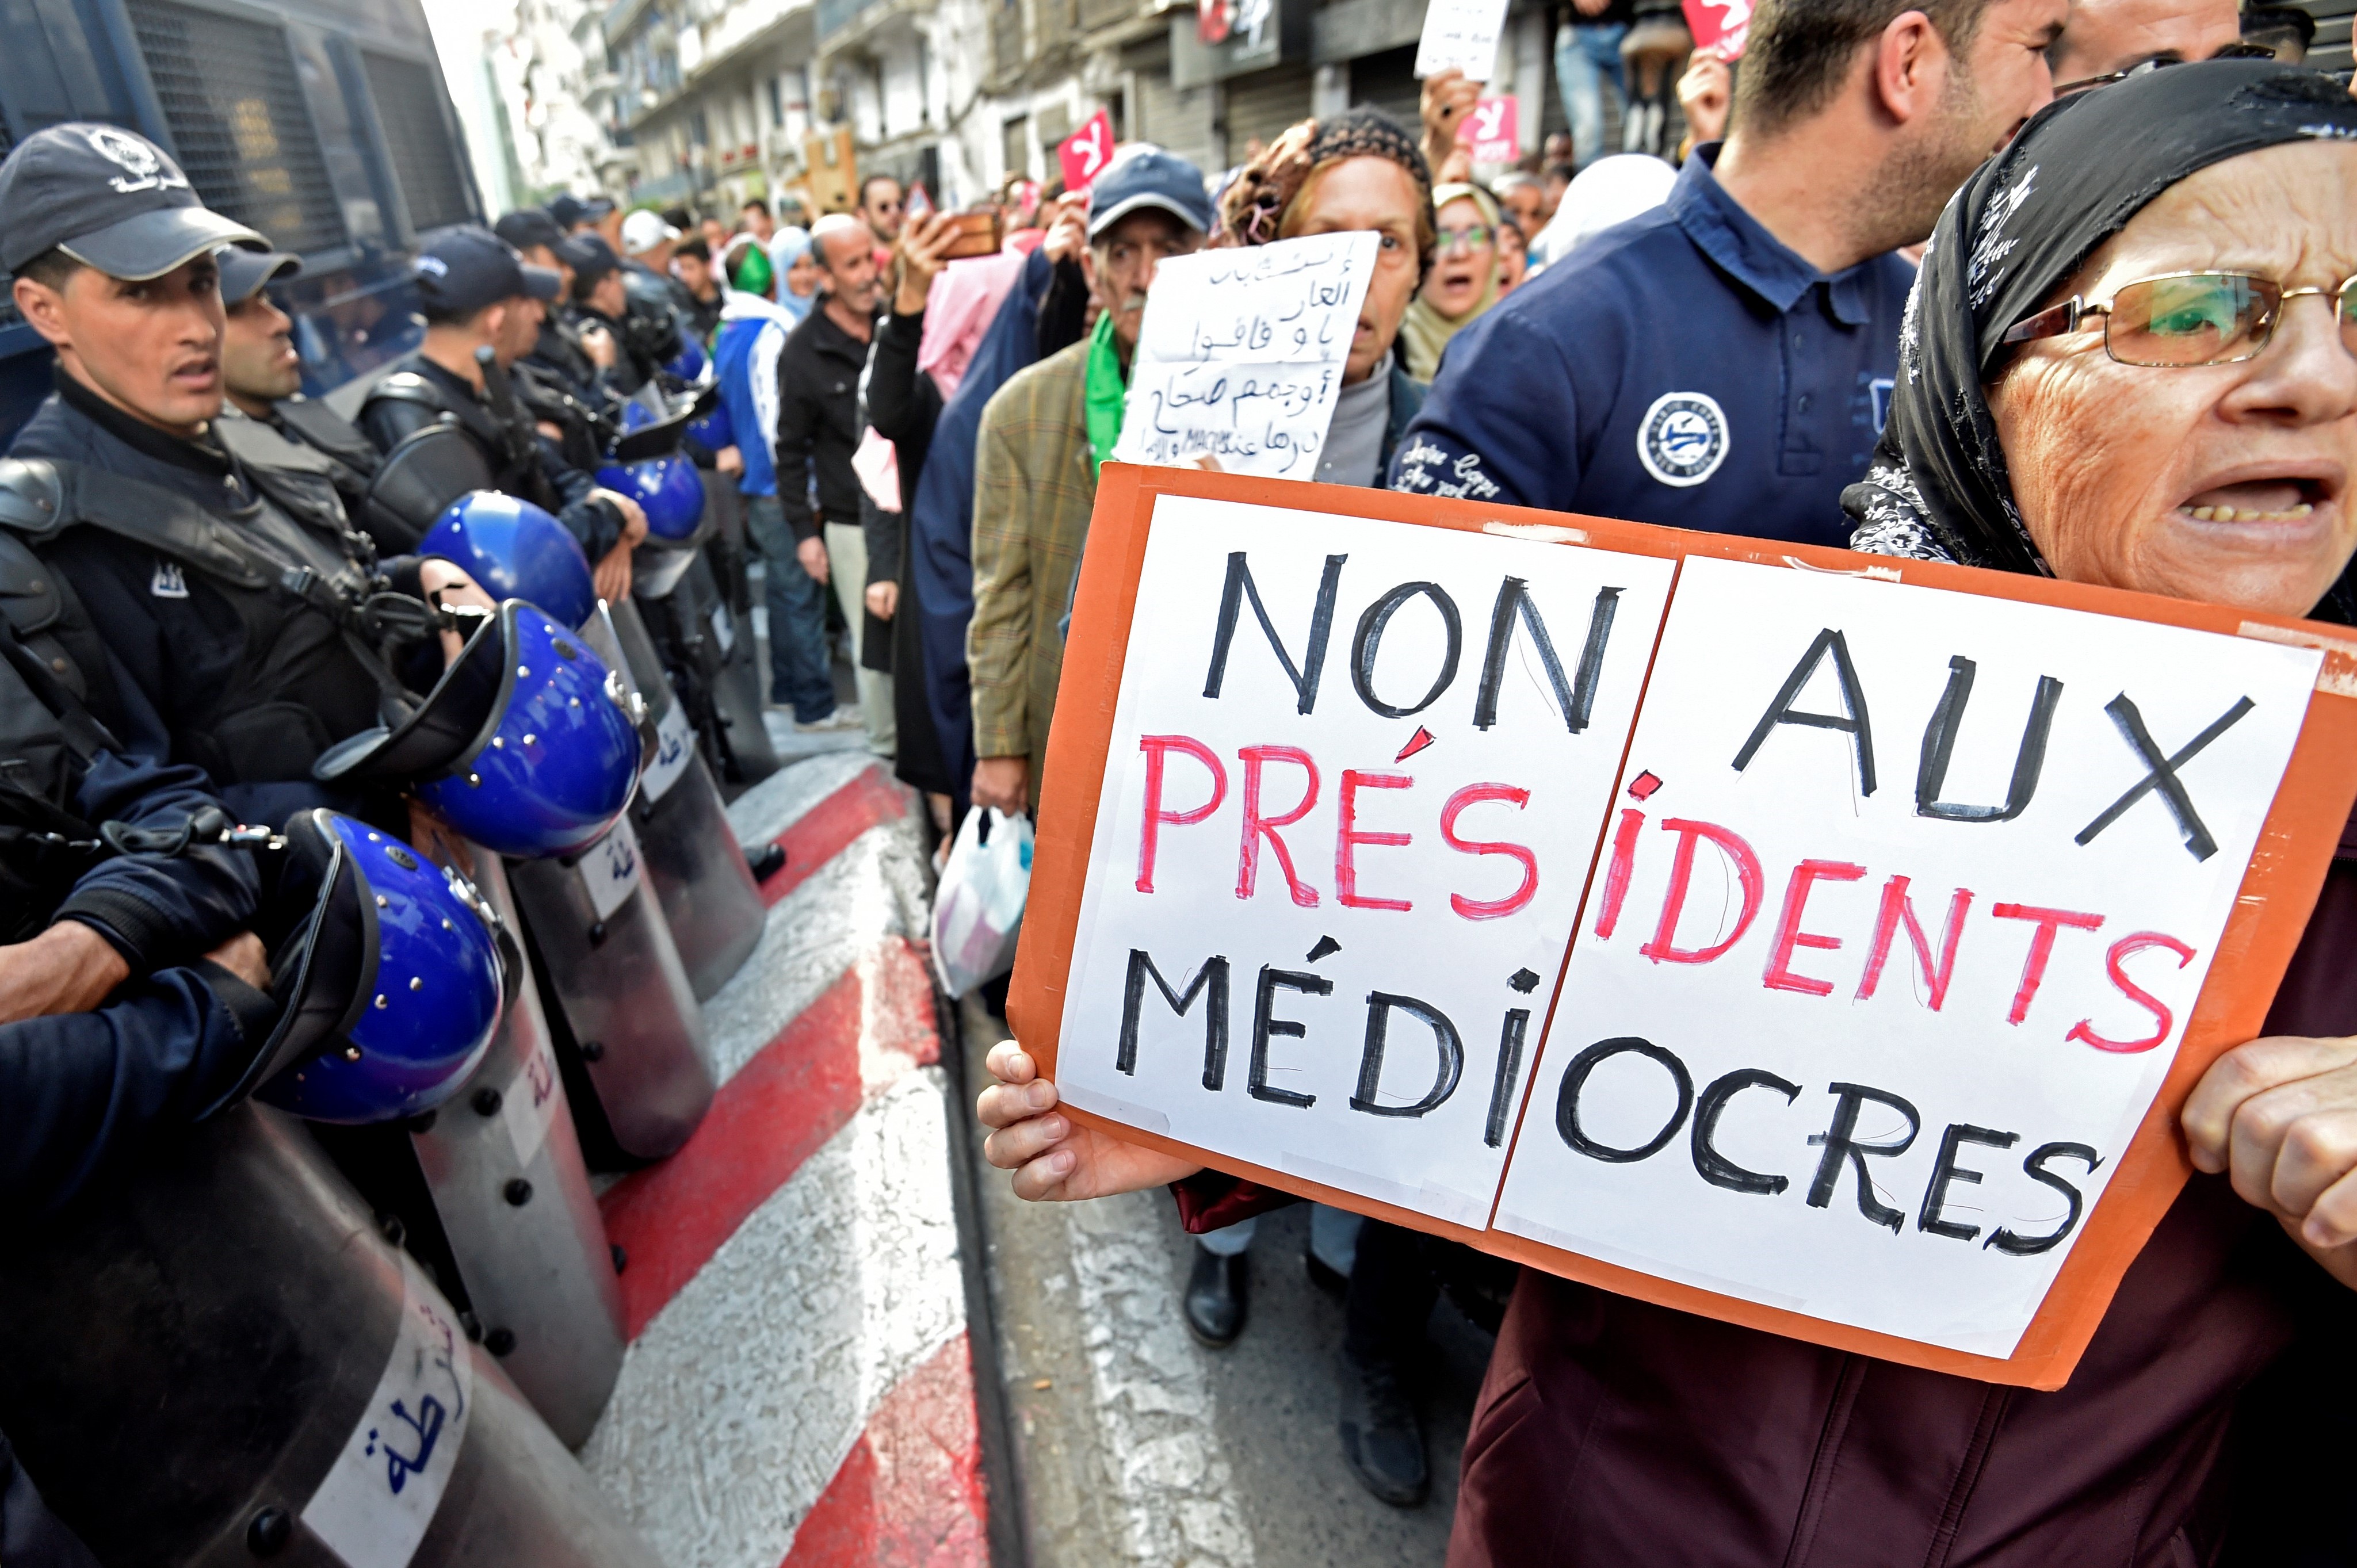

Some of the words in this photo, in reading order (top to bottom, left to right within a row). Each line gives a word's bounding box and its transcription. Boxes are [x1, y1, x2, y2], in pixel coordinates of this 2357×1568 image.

[1071, 121, 1102, 175] لا
[1278, 280, 1349, 322] العار
[1202, 551, 1628, 735] NON
[1731, 628, 2256, 862] AUX
[365, 1304, 465, 1495] شرطة
